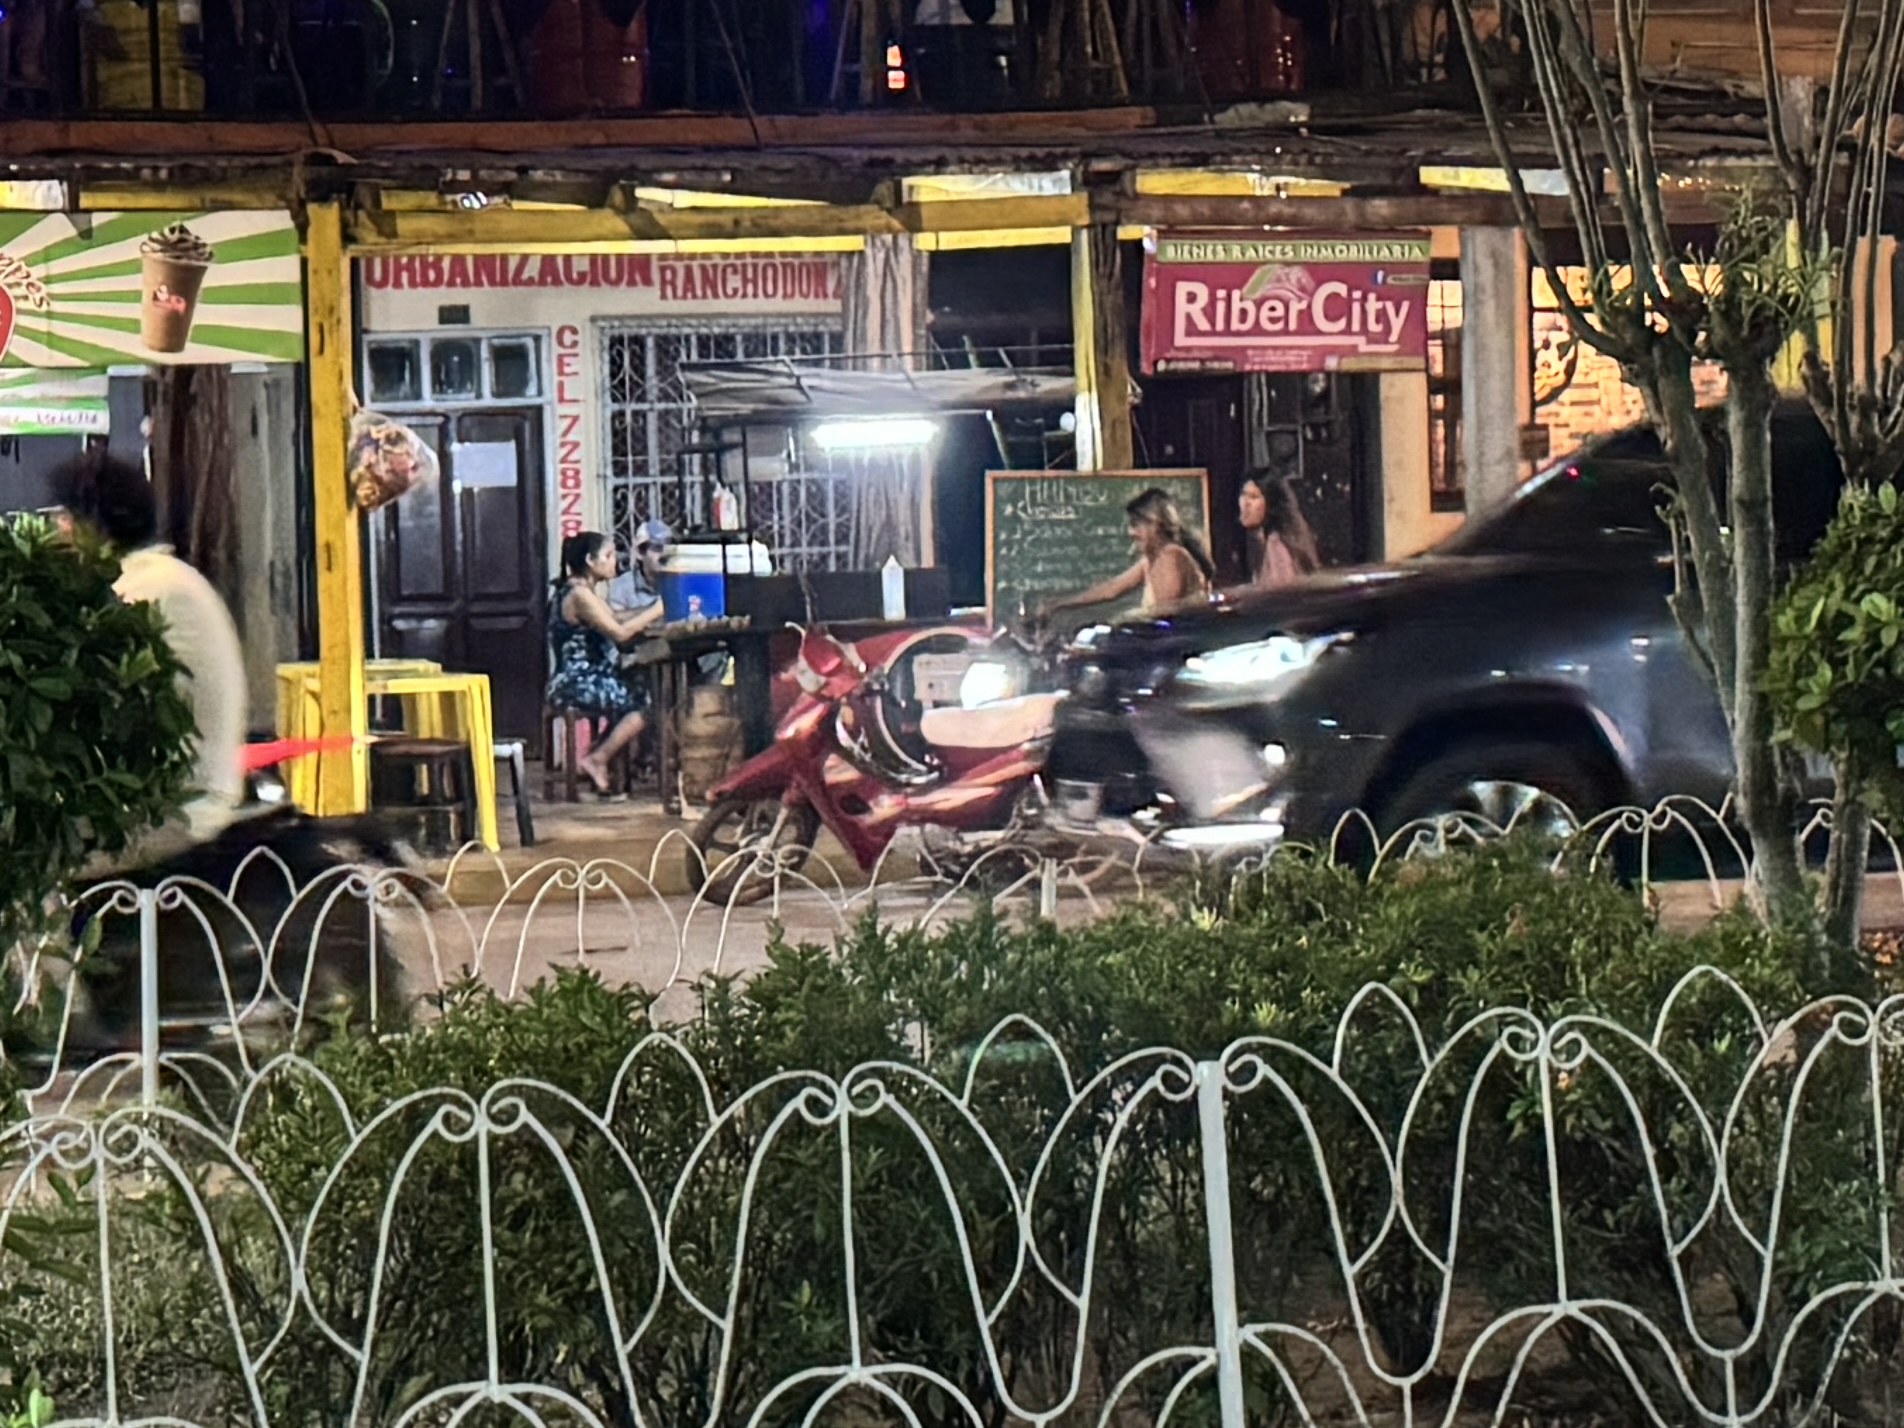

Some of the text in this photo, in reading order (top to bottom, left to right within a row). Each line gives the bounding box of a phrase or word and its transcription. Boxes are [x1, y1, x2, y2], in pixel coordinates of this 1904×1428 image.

[1166, 243, 1227, 260] BIENES
[1300, 243, 1424, 260] INMOBILIARIA
[555, 325, 583, 404] CEL
